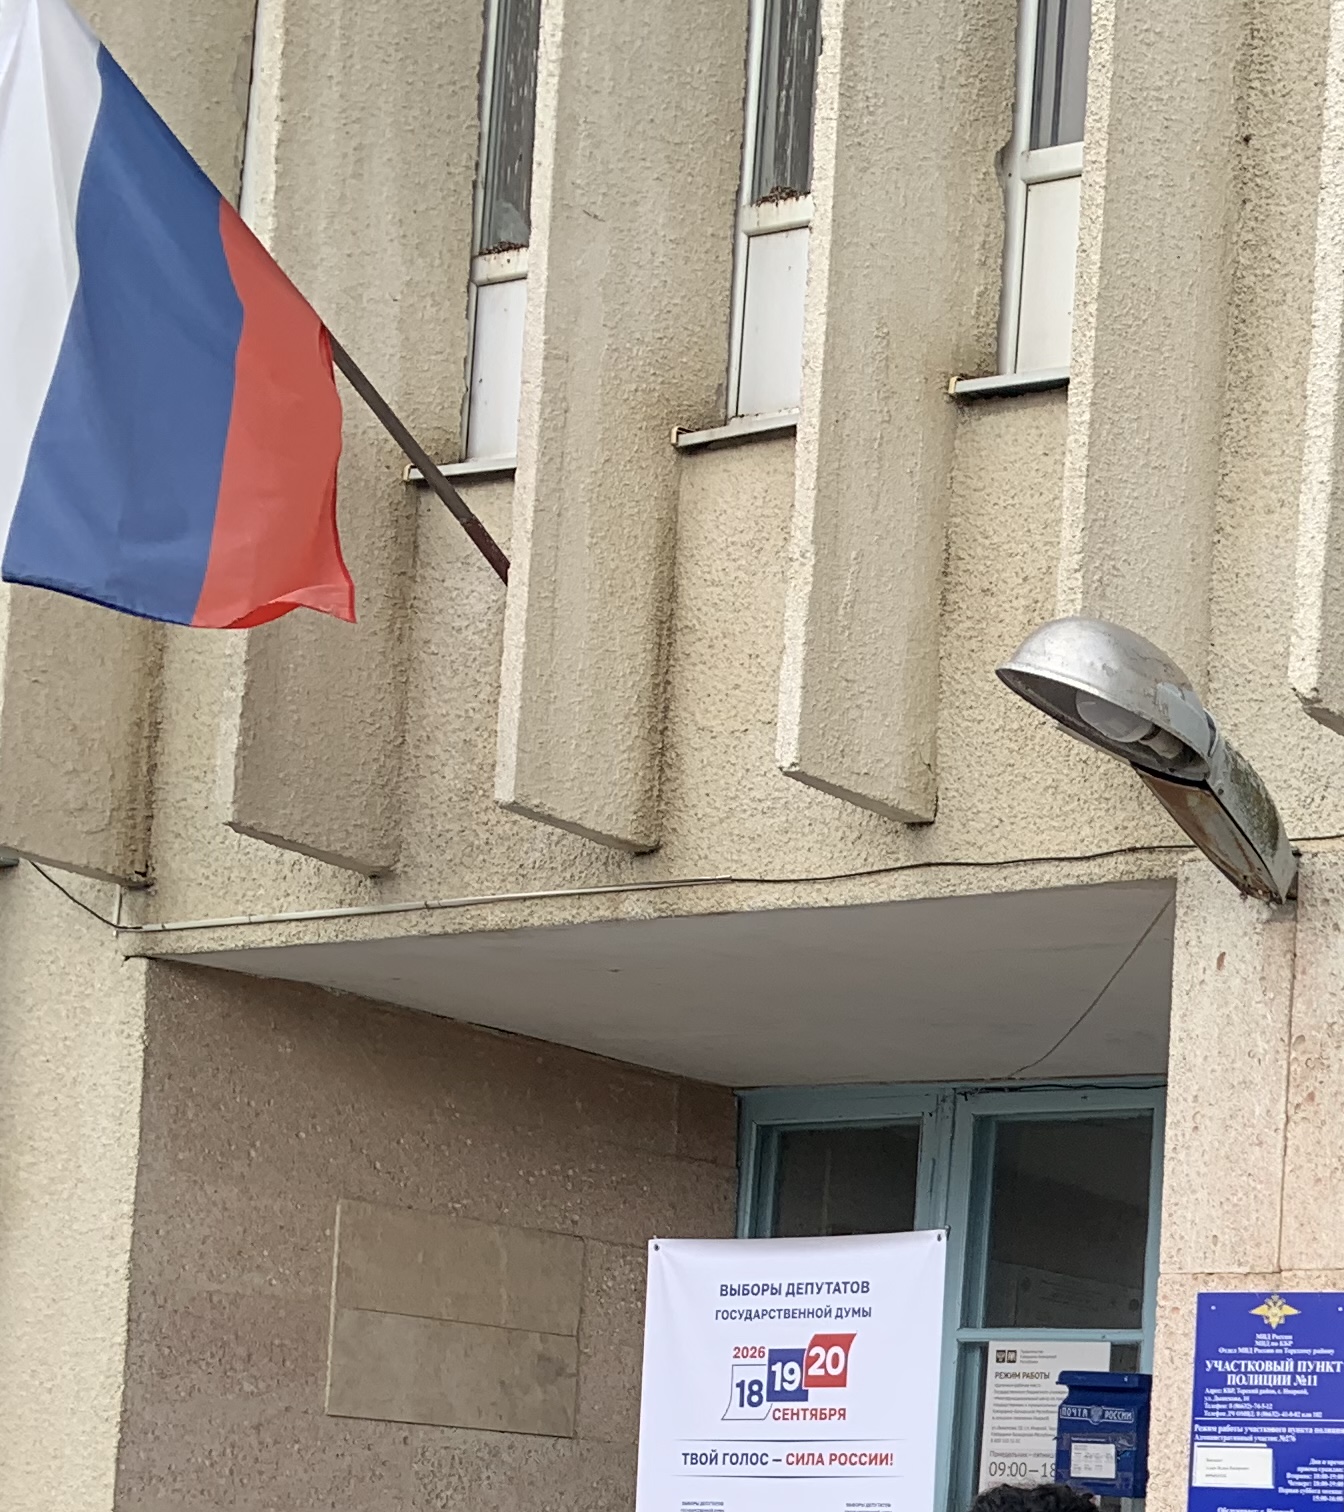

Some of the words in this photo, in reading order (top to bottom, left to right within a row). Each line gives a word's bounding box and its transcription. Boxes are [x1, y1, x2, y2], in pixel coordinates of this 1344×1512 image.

[719, 1283, 782, 1297] ВЫБОРЫ
[785, 1281, 870, 1297] ДЕПУТАТОВ
[715, 1305, 832, 1321] ГОСУДАРСТВЕННОЙ
[834, 1307, 872, 1320] ДУМЫ
[732, 1346, 766, 1359] 2026
[1205, 1358, 1294, 1372] УЧАСТКОВЫЙ
[1297, 1361, 1344, 1373] ПУНКТ
[735, 1379, 764, 1408] 18
[771, 1361, 802, 1392] 19
[807, 1346, 846, 1376] 20
[995, 1371, 1021, 1380] РЕЖИМ
[1022, 1371, 1050, 1380] РАБОТЫ
[1226, 1374, 1291, 1387] ПОЛИЦИИ
[1293, 1374, 1318, 1386] №11
[772, 1407, 847, 1421] СЕНТЯБРЯ
[1061, 1407, 1088, 1417] ПОЧТА
[1104, 1410, 1132, 1420] РОССИИ
[682, 1449, 719, 1466] ТВОЙ
[722, 1452, 769, 1466] ГОЛОС
[785, 1452, 825, 1467] СИЛА
[828, 1452, 894, 1467] РОССИИ!
